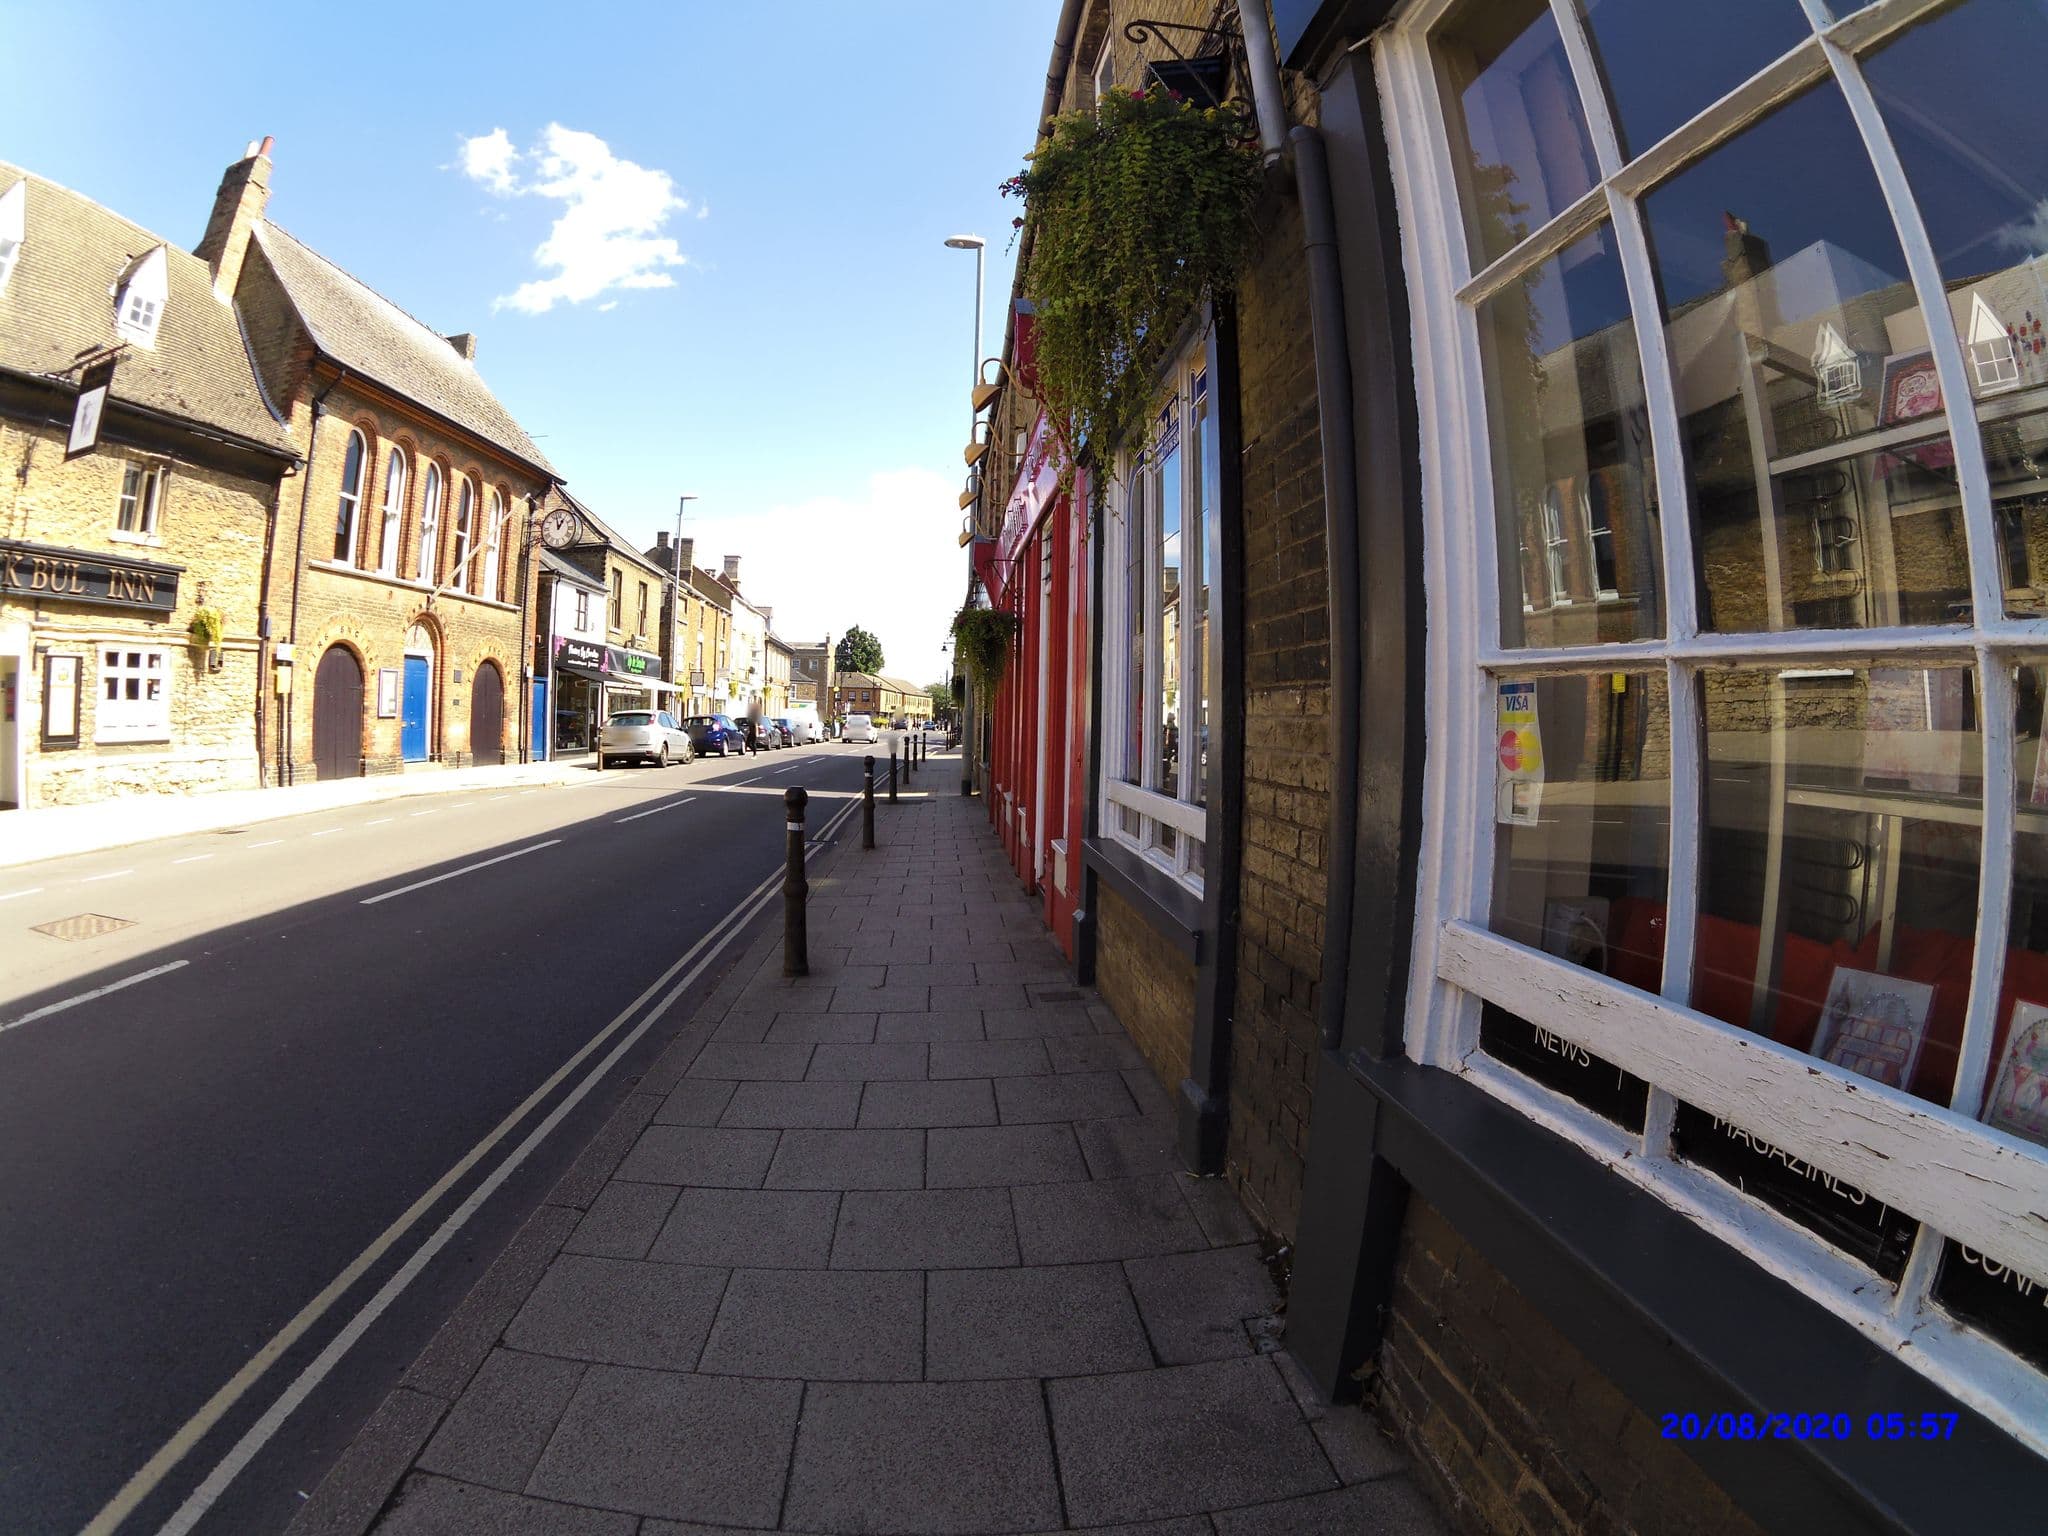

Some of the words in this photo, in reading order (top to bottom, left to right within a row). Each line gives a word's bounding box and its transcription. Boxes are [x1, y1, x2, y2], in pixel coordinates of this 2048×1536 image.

[107, 568, 157, 602] INN
[1505, 695, 1529, 712] VISA
[1533, 1026, 1591, 1068] NEWS
